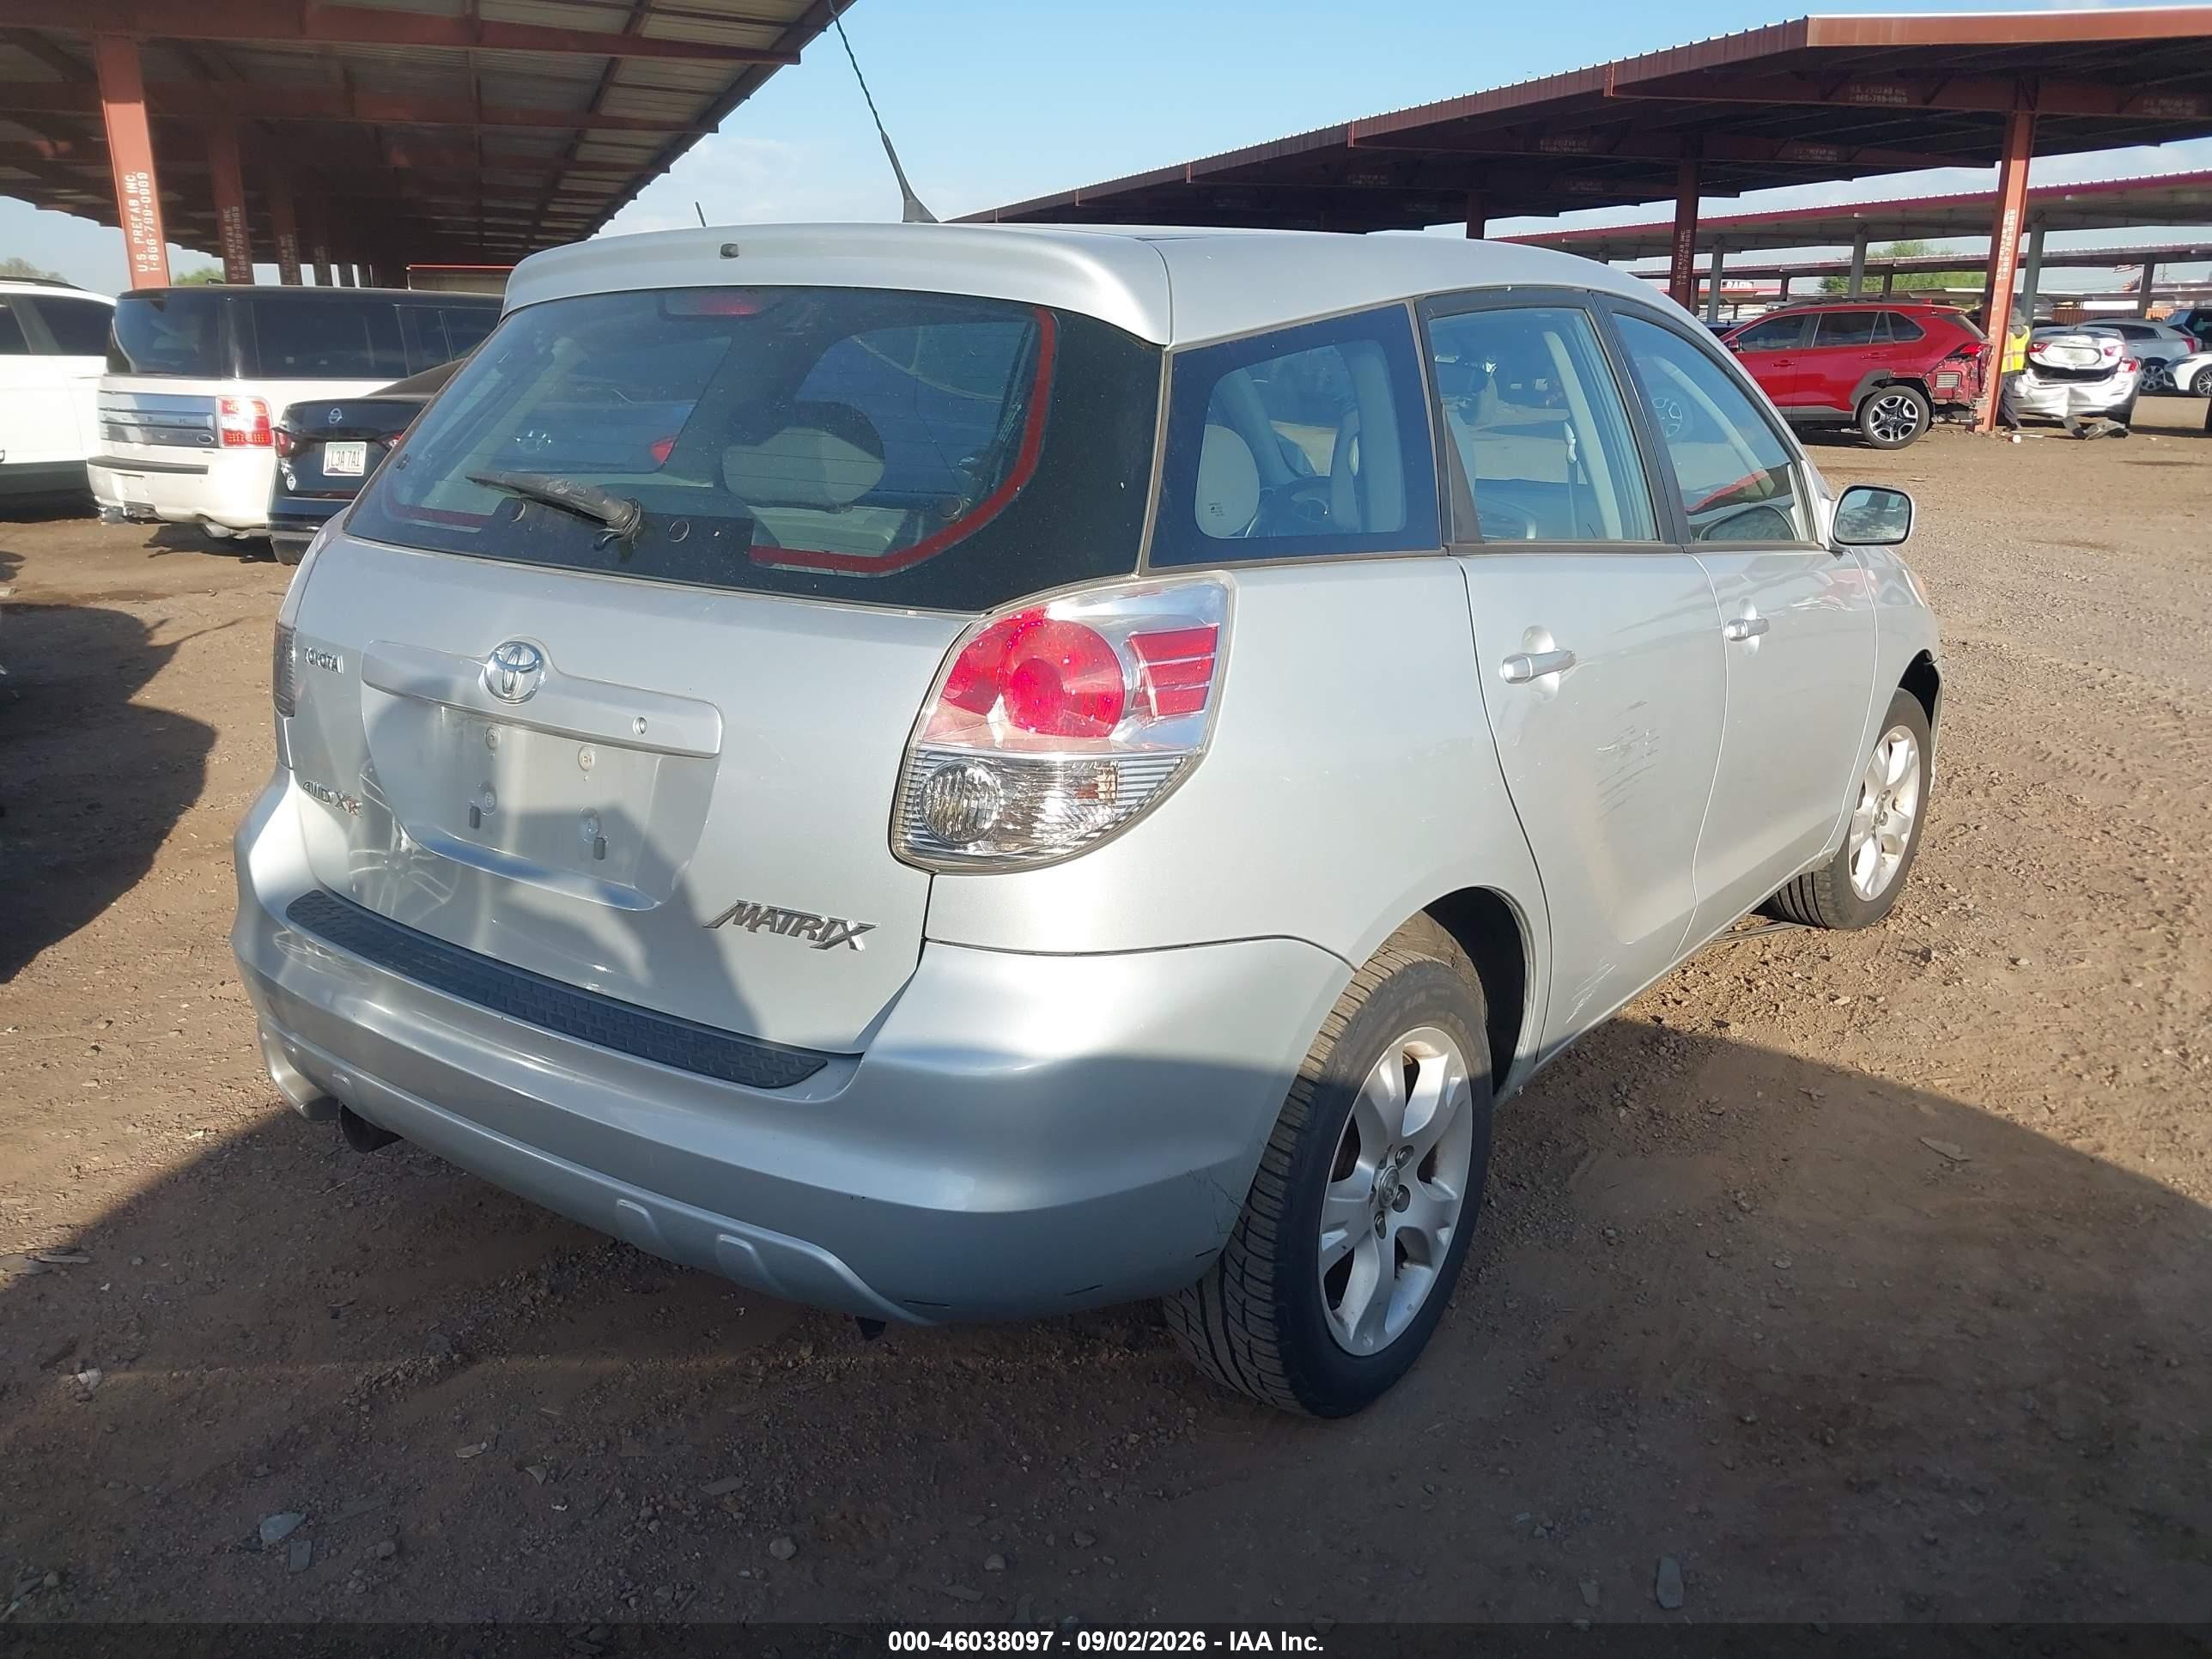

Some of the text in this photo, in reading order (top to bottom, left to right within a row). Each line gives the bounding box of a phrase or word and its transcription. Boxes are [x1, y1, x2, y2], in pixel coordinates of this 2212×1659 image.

[125, 171, 149, 272] U.S. PREFAB INC.
[304, 647, 343, 674] TOYOTA
[702, 900, 879, 951] MATRIX
